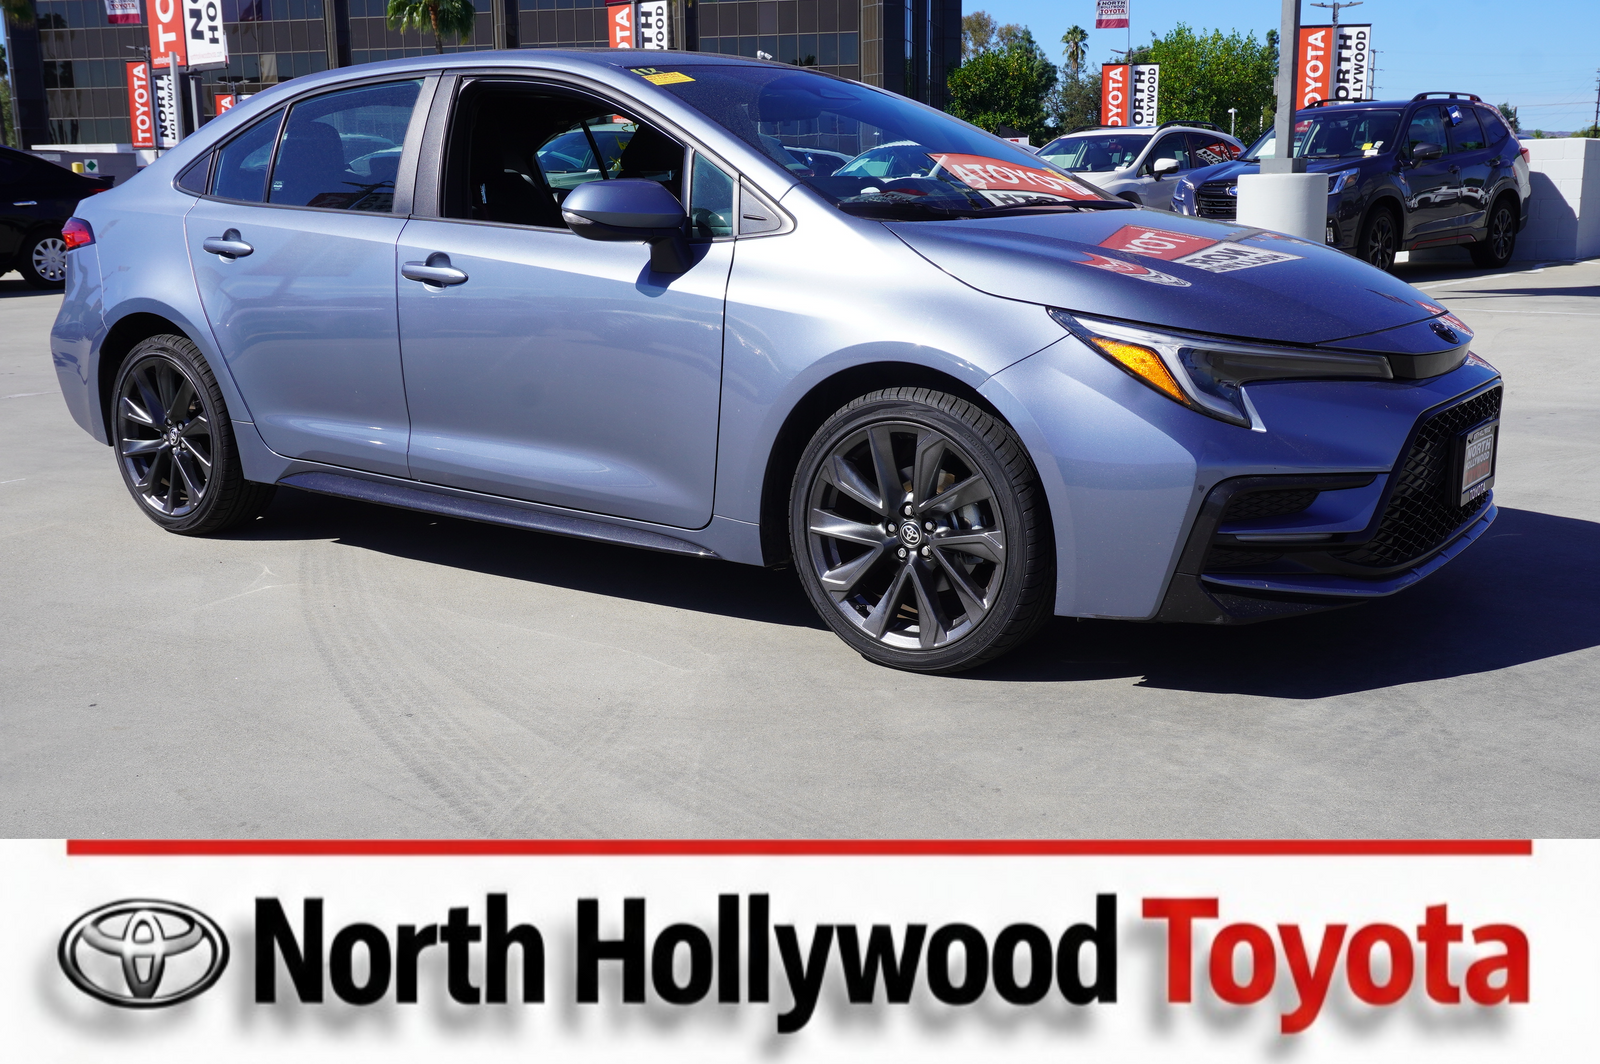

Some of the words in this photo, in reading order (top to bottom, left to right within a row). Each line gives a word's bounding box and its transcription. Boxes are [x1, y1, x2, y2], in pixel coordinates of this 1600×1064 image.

[132, 64, 151, 142] TOYOTA
[1132, 70, 1146, 125] ORTH
[1146, 67, 1157, 126] LLYWOOD
[1466, 438, 1492, 460] NORTH
